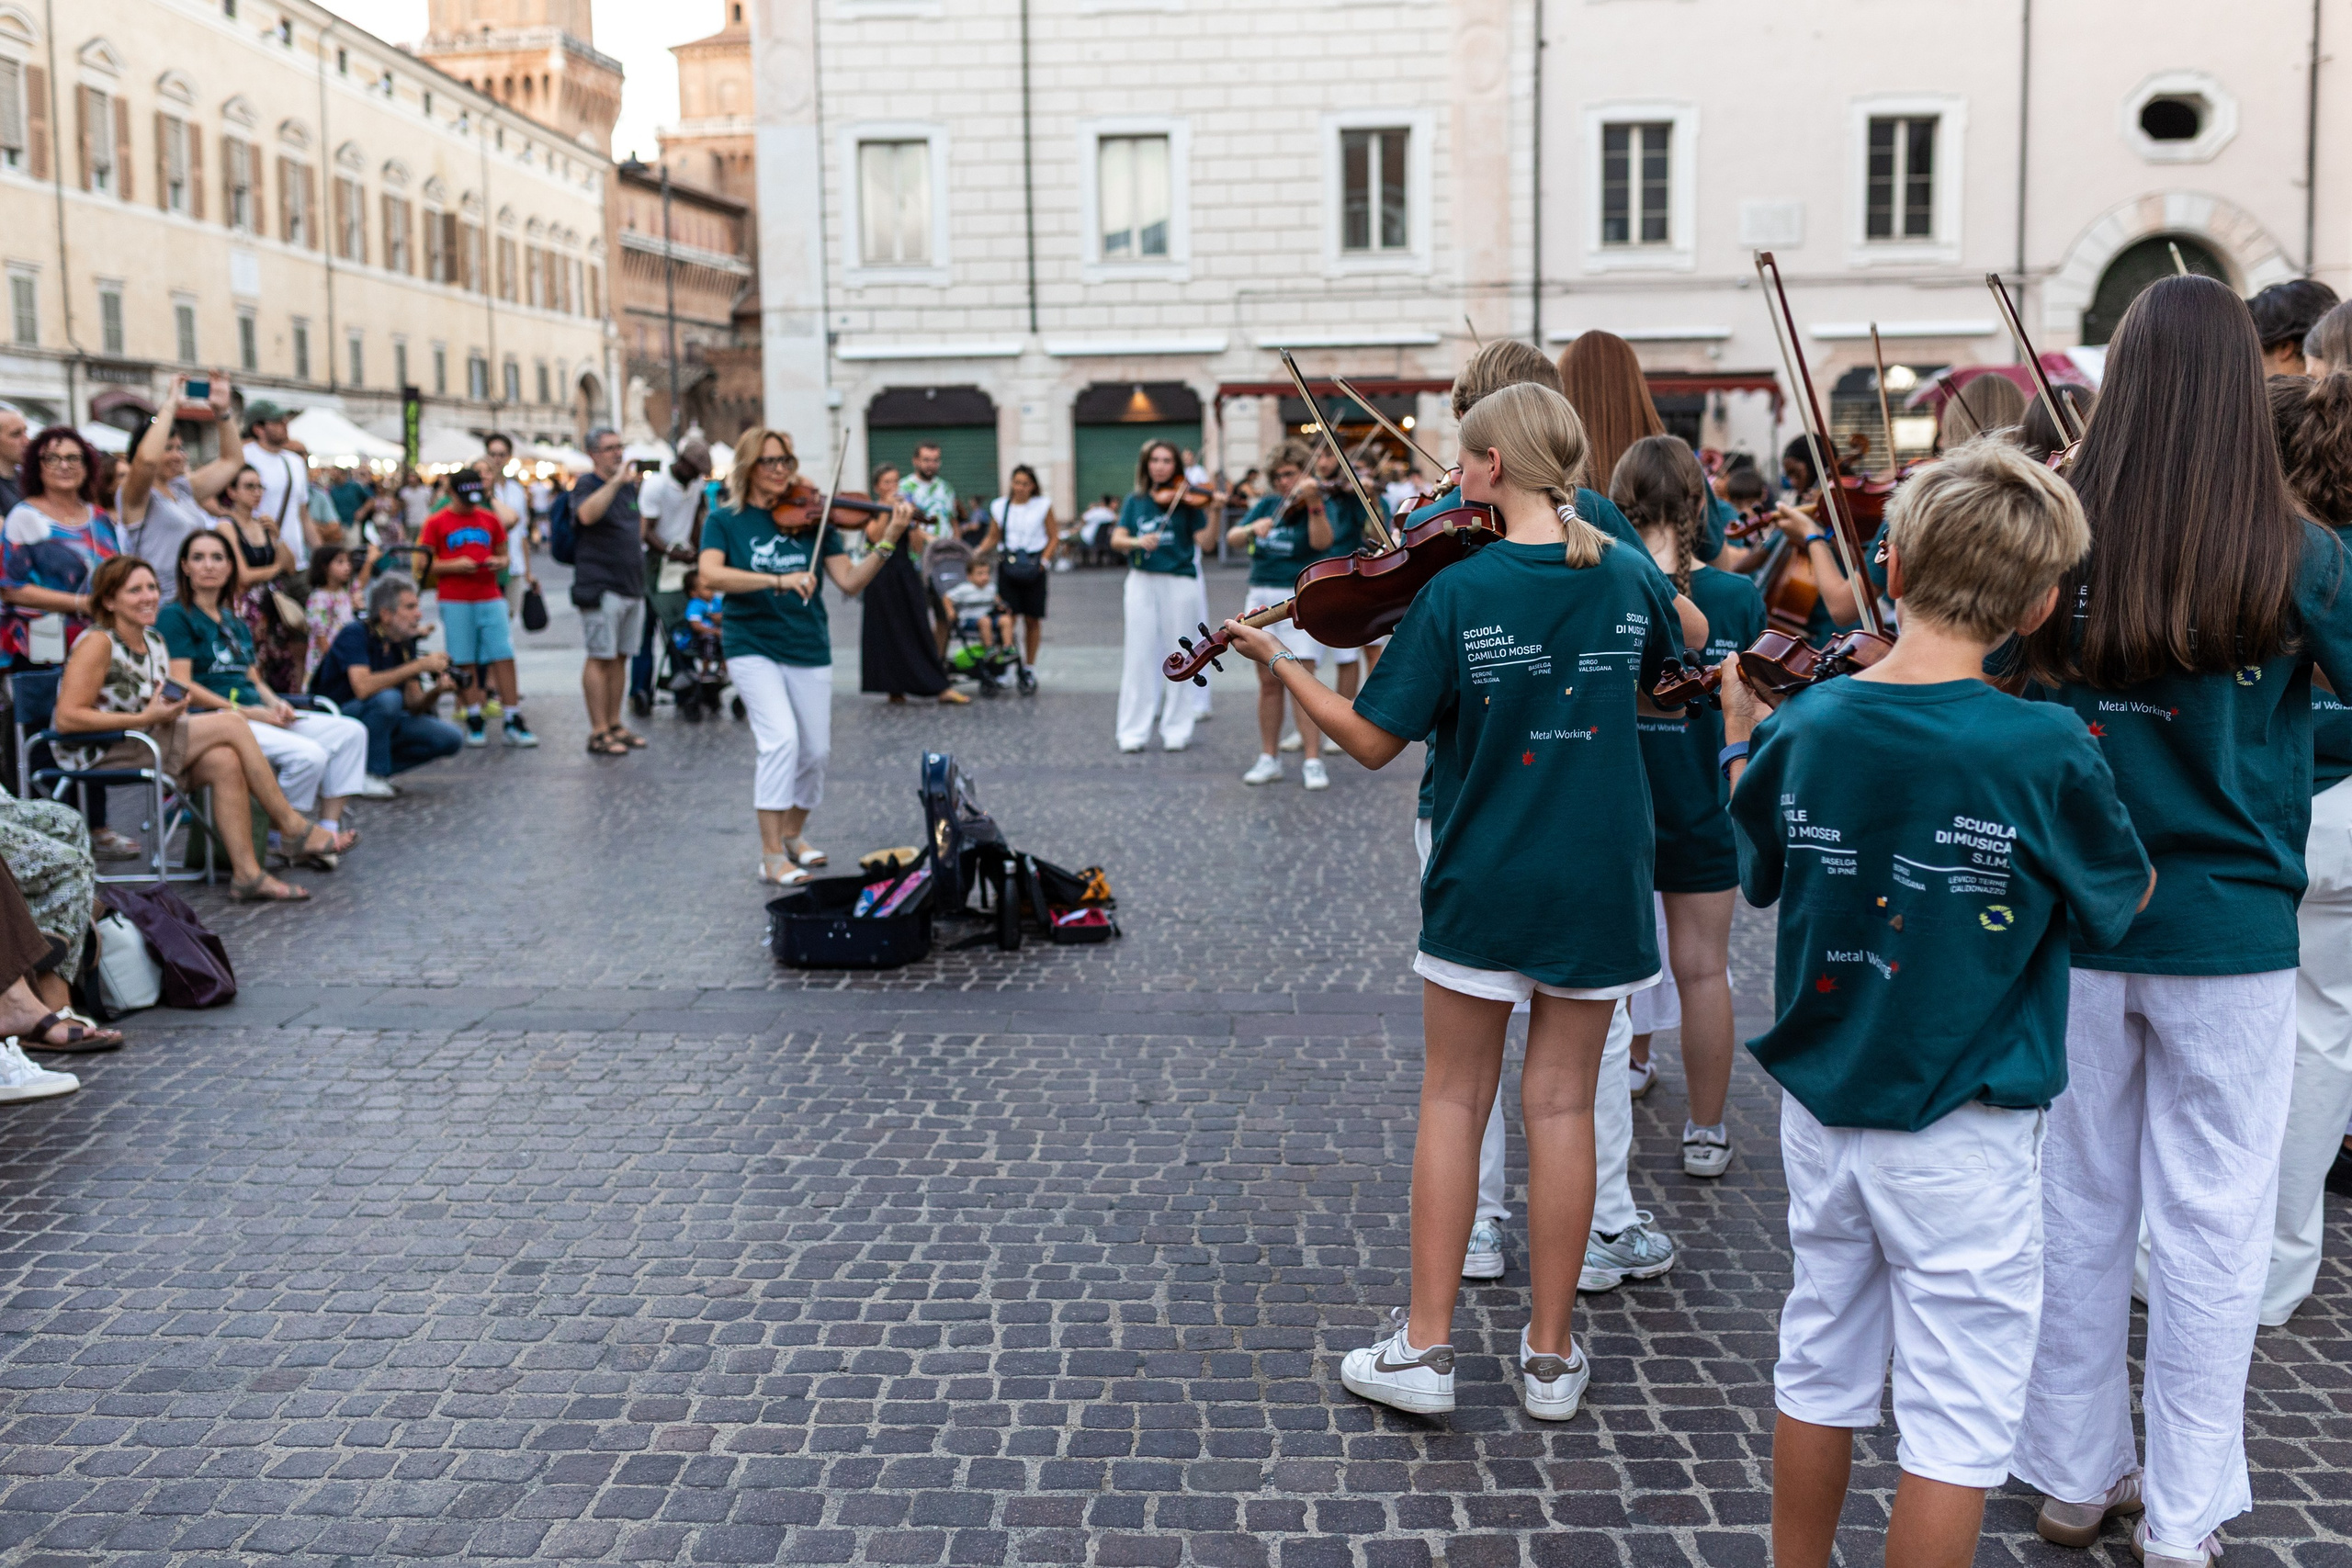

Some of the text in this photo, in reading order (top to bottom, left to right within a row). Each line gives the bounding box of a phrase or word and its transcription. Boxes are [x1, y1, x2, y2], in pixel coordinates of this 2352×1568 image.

[1626, 613, 1649, 625] SCUOLA
[1463, 625, 1503, 639] SCUOLA
[1616, 625, 1626, 634] DI
[1464, 636, 1514, 651] MUSICALE
[1467, 644, 1543, 662] CAMILLO MOSER
[1528, 662, 1552, 671] BASELGA
[2098, 700, 2172, 722] Metal Working
[1530, 728, 1592, 740] Metal Working
[1657, 723, 1685, 734] Working
[1799, 826, 1841, 842] MOSER
[1953, 816, 2017, 840] SCUOLA
[1935, 829, 2012, 854] DI MUSICA
[1820, 856, 1858, 866] BASELGA
[1972, 852, 2010, 869] S.I.M.
[1826, 866, 1857, 875] DI PINÉ
[1948, 875, 1977, 885] LEVICO
[1950, 884, 2007, 896] CALDONAZZO
[1826, 950, 1863, 962] Metal
